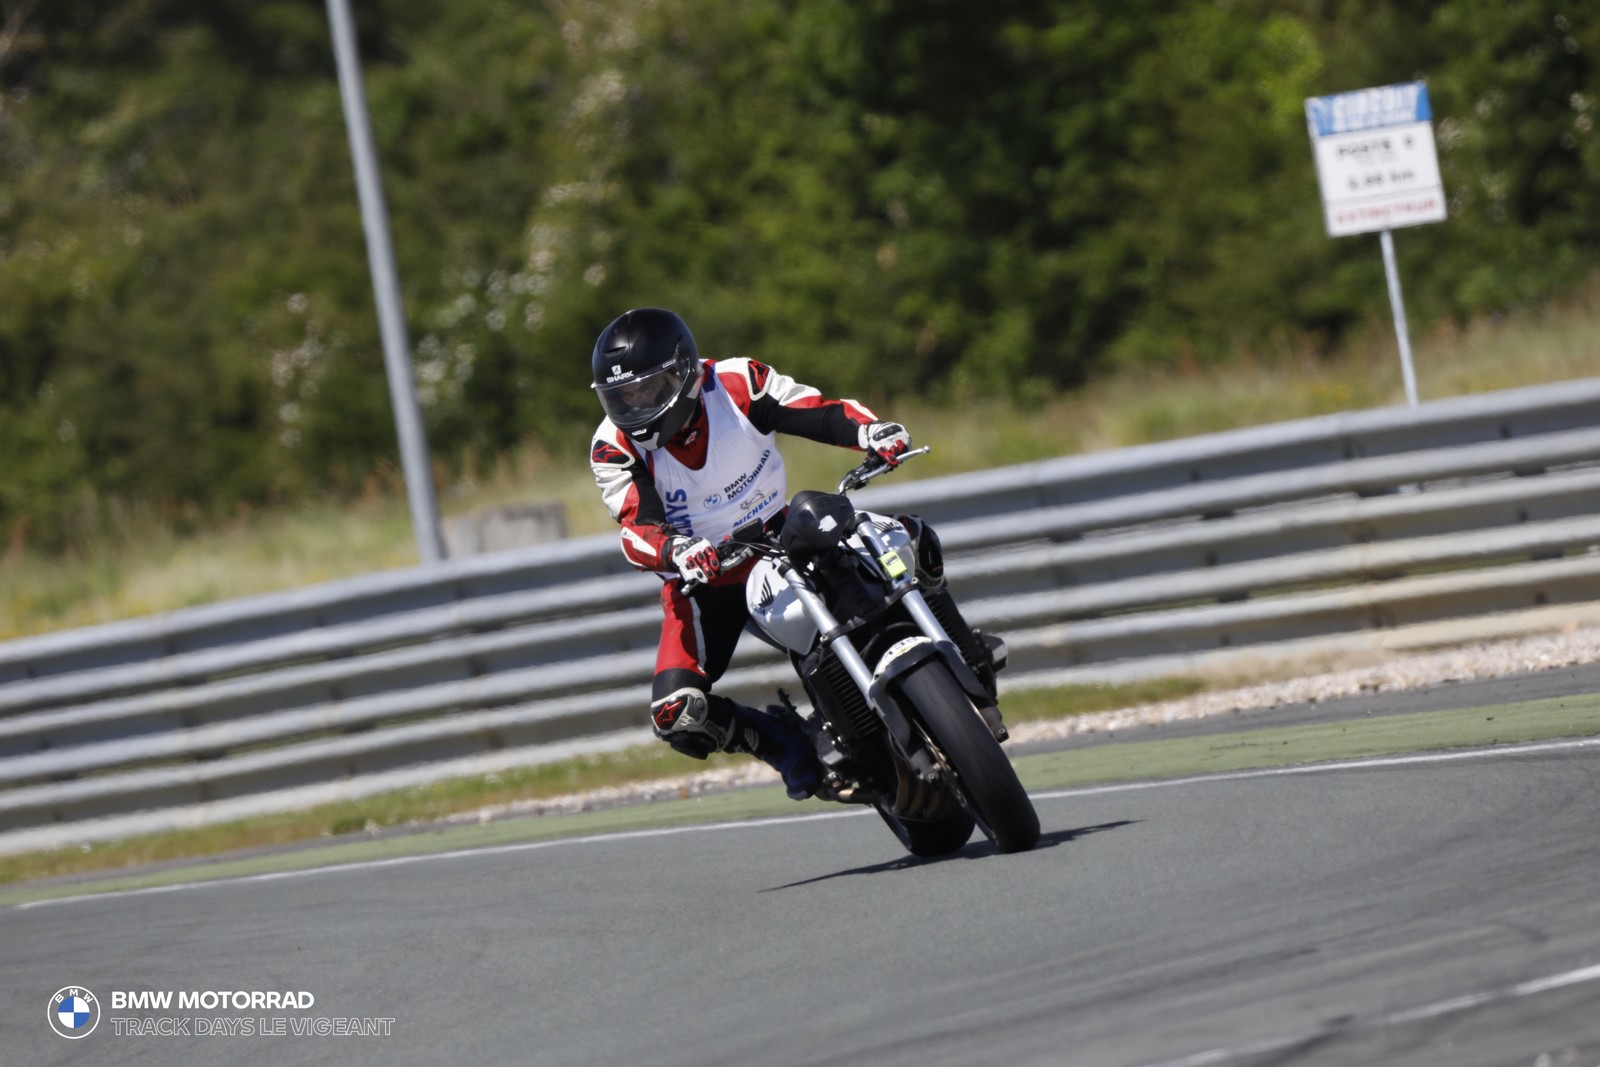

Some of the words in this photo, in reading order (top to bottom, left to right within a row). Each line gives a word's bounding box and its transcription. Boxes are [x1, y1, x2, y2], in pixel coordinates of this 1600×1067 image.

[606, 370, 634, 384] SHARK
[723, 472, 747, 494] BMW
[727, 449, 771, 501] MOTORRAD
[732, 490, 778, 528] MICHELIN
